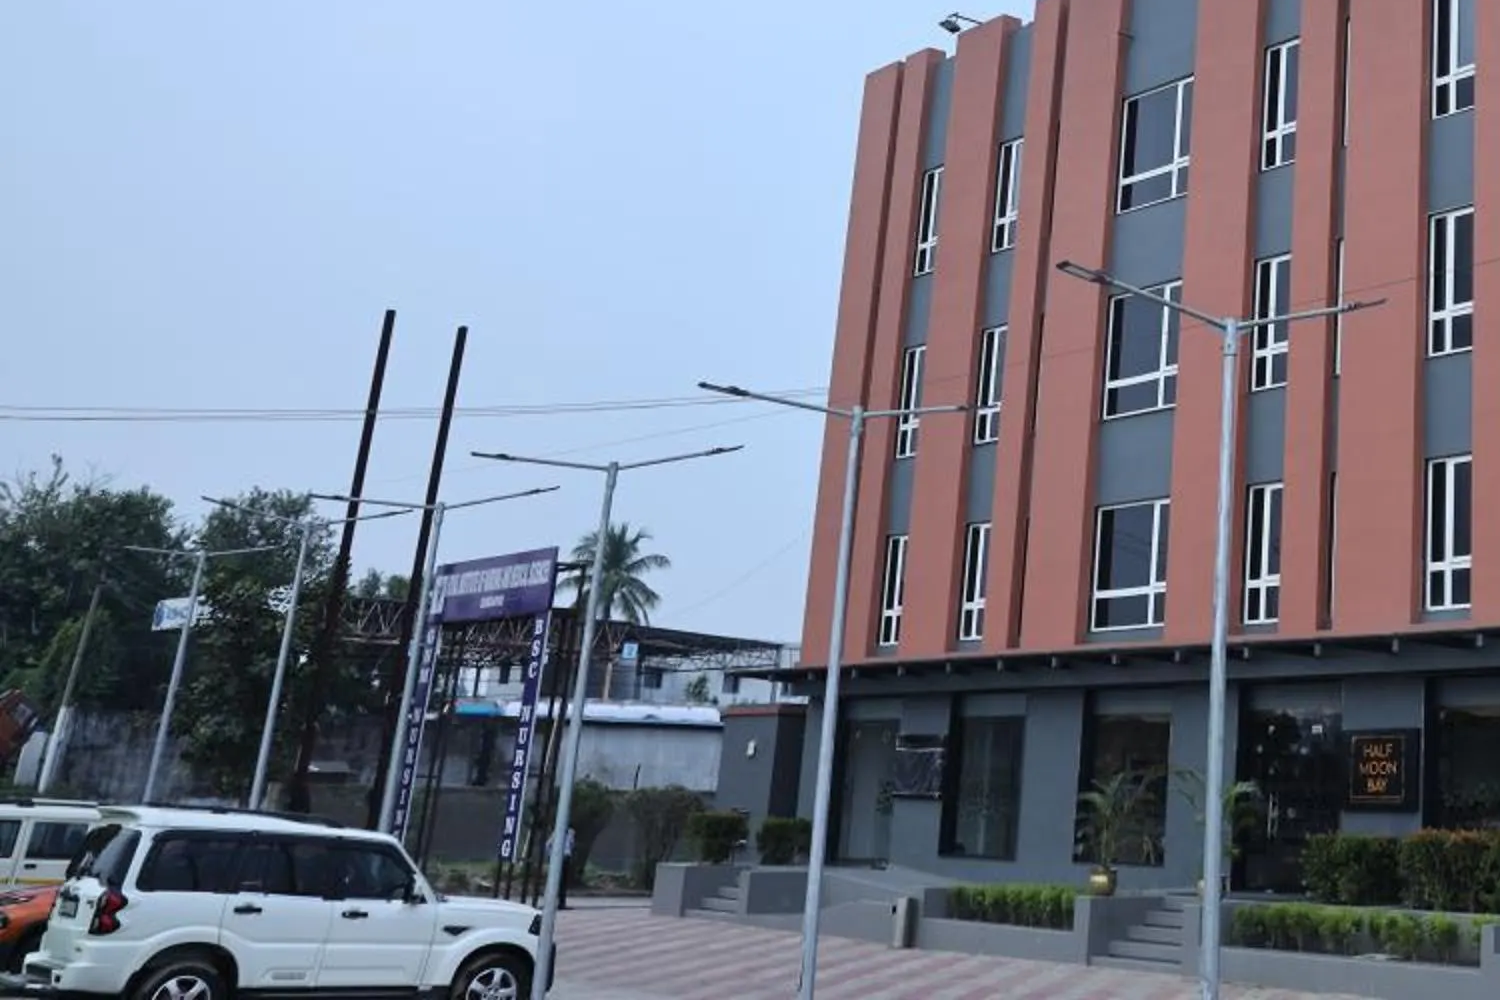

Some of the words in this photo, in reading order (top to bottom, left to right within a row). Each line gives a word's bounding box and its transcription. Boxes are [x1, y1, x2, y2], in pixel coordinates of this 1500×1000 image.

[1363, 744, 1393, 757] HALF
[394, 707, 422, 838] NURSIN
[1359, 761, 1398, 774] MOON
[501, 705, 533, 857] NURSING
[1367, 778, 1388, 793] BAY
